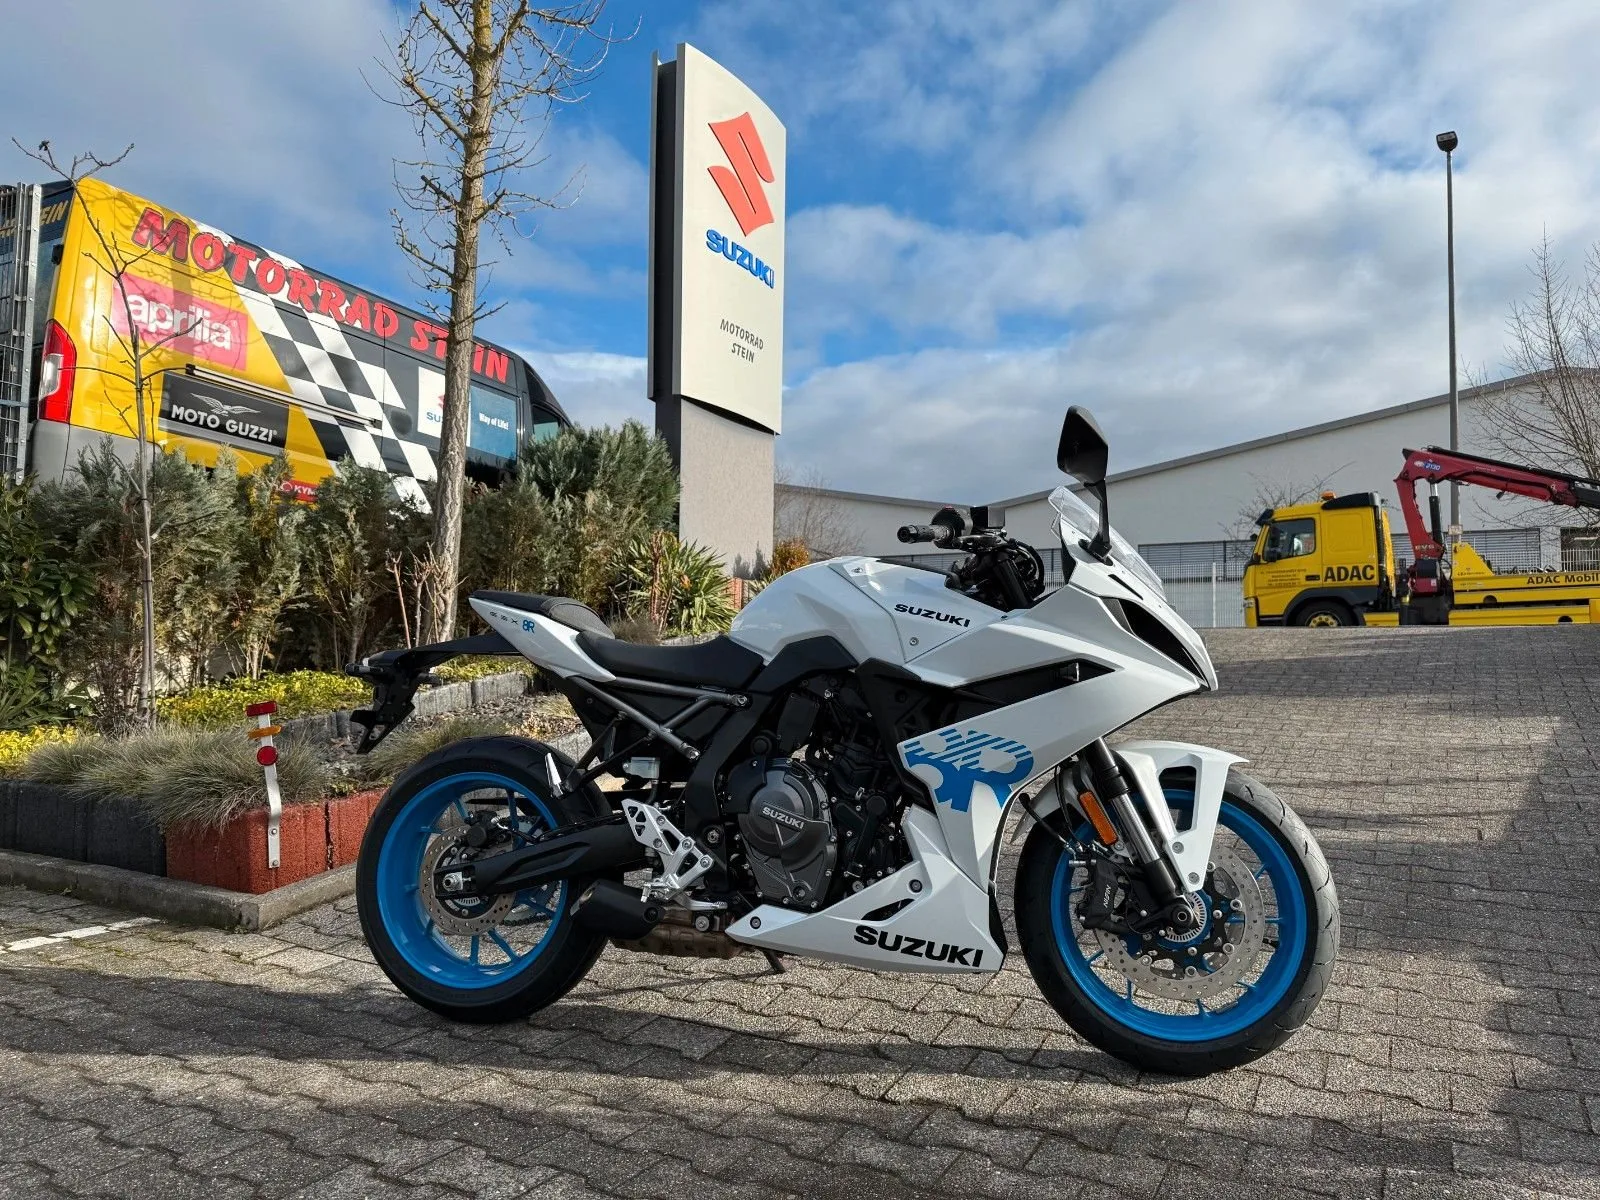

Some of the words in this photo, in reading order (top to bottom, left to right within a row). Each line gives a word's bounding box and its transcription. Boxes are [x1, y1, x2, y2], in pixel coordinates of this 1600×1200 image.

[706, 229, 775, 289] SUZUKI
[131, 207, 399, 338] MOTORRAD
[410, 320, 508, 383] STIN
[127, 294, 231, 350] aprilia
[720, 319, 764, 350] MOTORRAD
[731, 343, 754, 363] STEIN
[171, 404, 220, 428] MOTO
[225, 419, 275, 443] GUZZI
[479, 412, 490, 425] Way
[491, 418, 497, 426] of
[294, 485, 316, 495] KYM
[1324, 565, 1374, 582] ADAC
[1527, 575, 1561, 585] ADAC
[894, 603, 970, 628] SUZUKI
[762, 806, 804, 828] SUZUKI
[853, 924, 984, 968] SUZUKI
